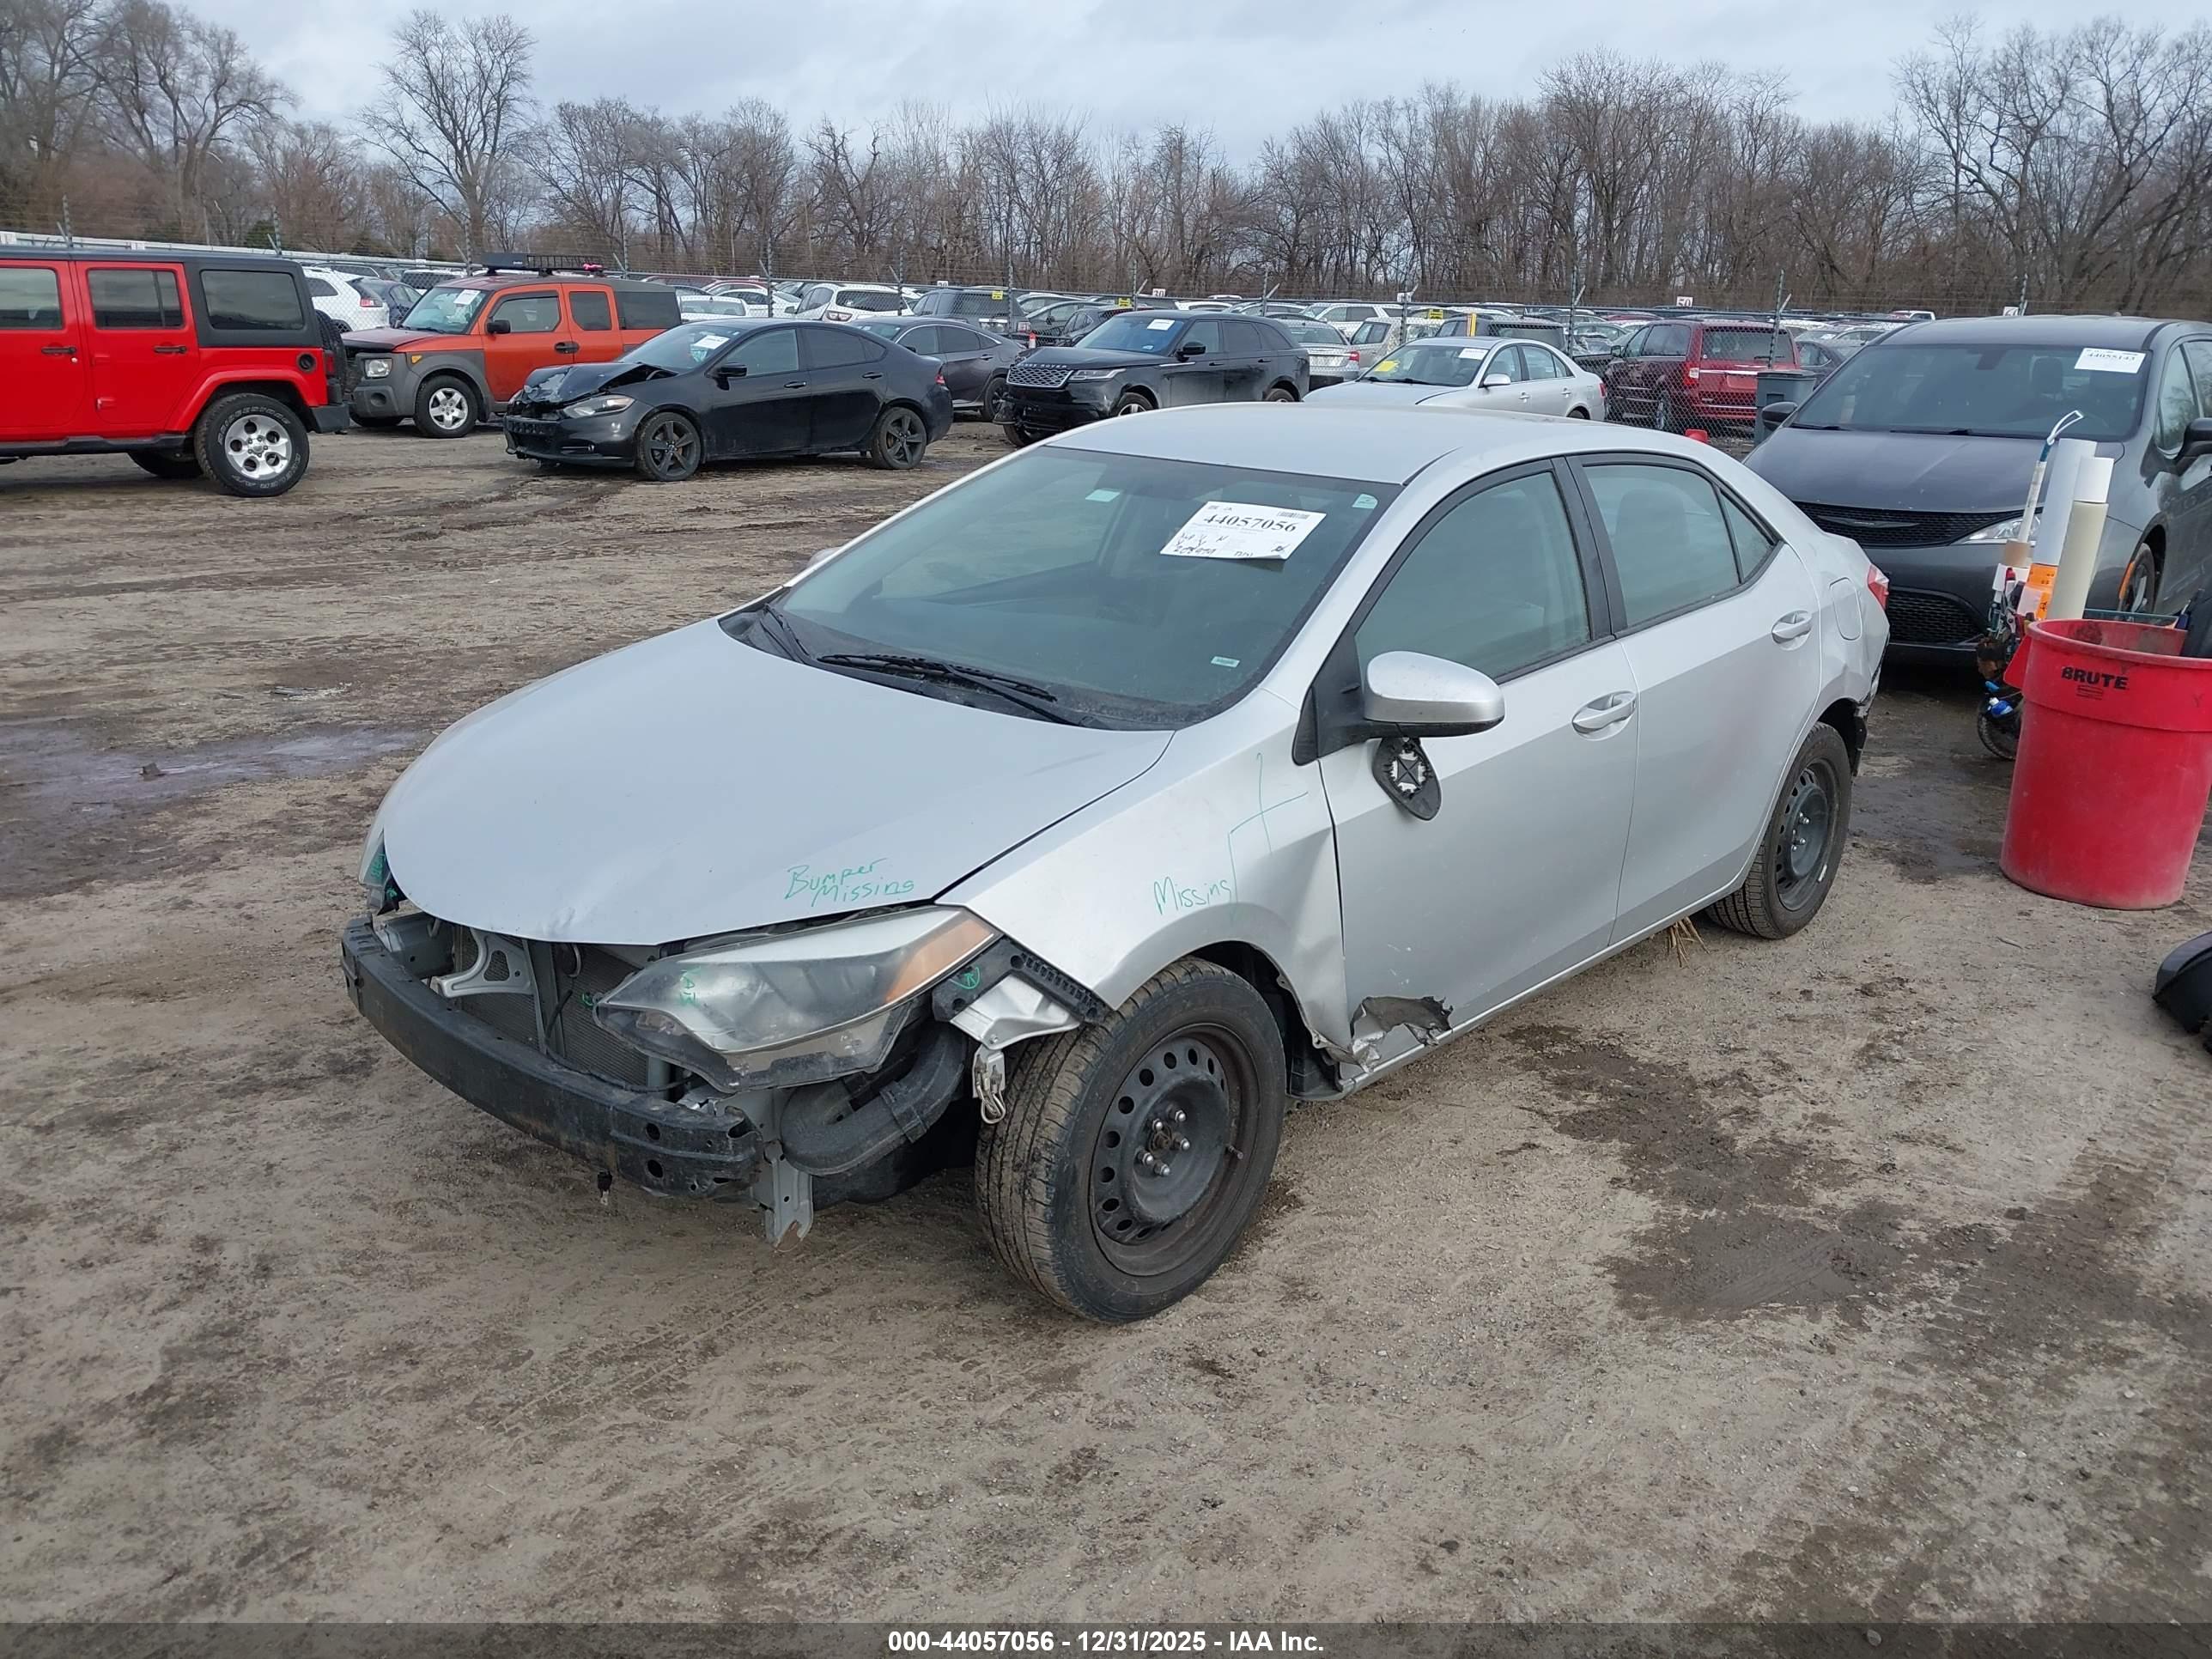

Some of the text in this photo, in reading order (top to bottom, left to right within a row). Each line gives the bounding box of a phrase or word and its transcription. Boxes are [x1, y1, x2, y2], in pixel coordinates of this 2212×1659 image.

[1678, 298, 1692, 307] 50
[1204, 514, 1297, 532] 44057056
[2061, 666, 2129, 690] BRUTE
[785, 858, 888, 899] Bumper
